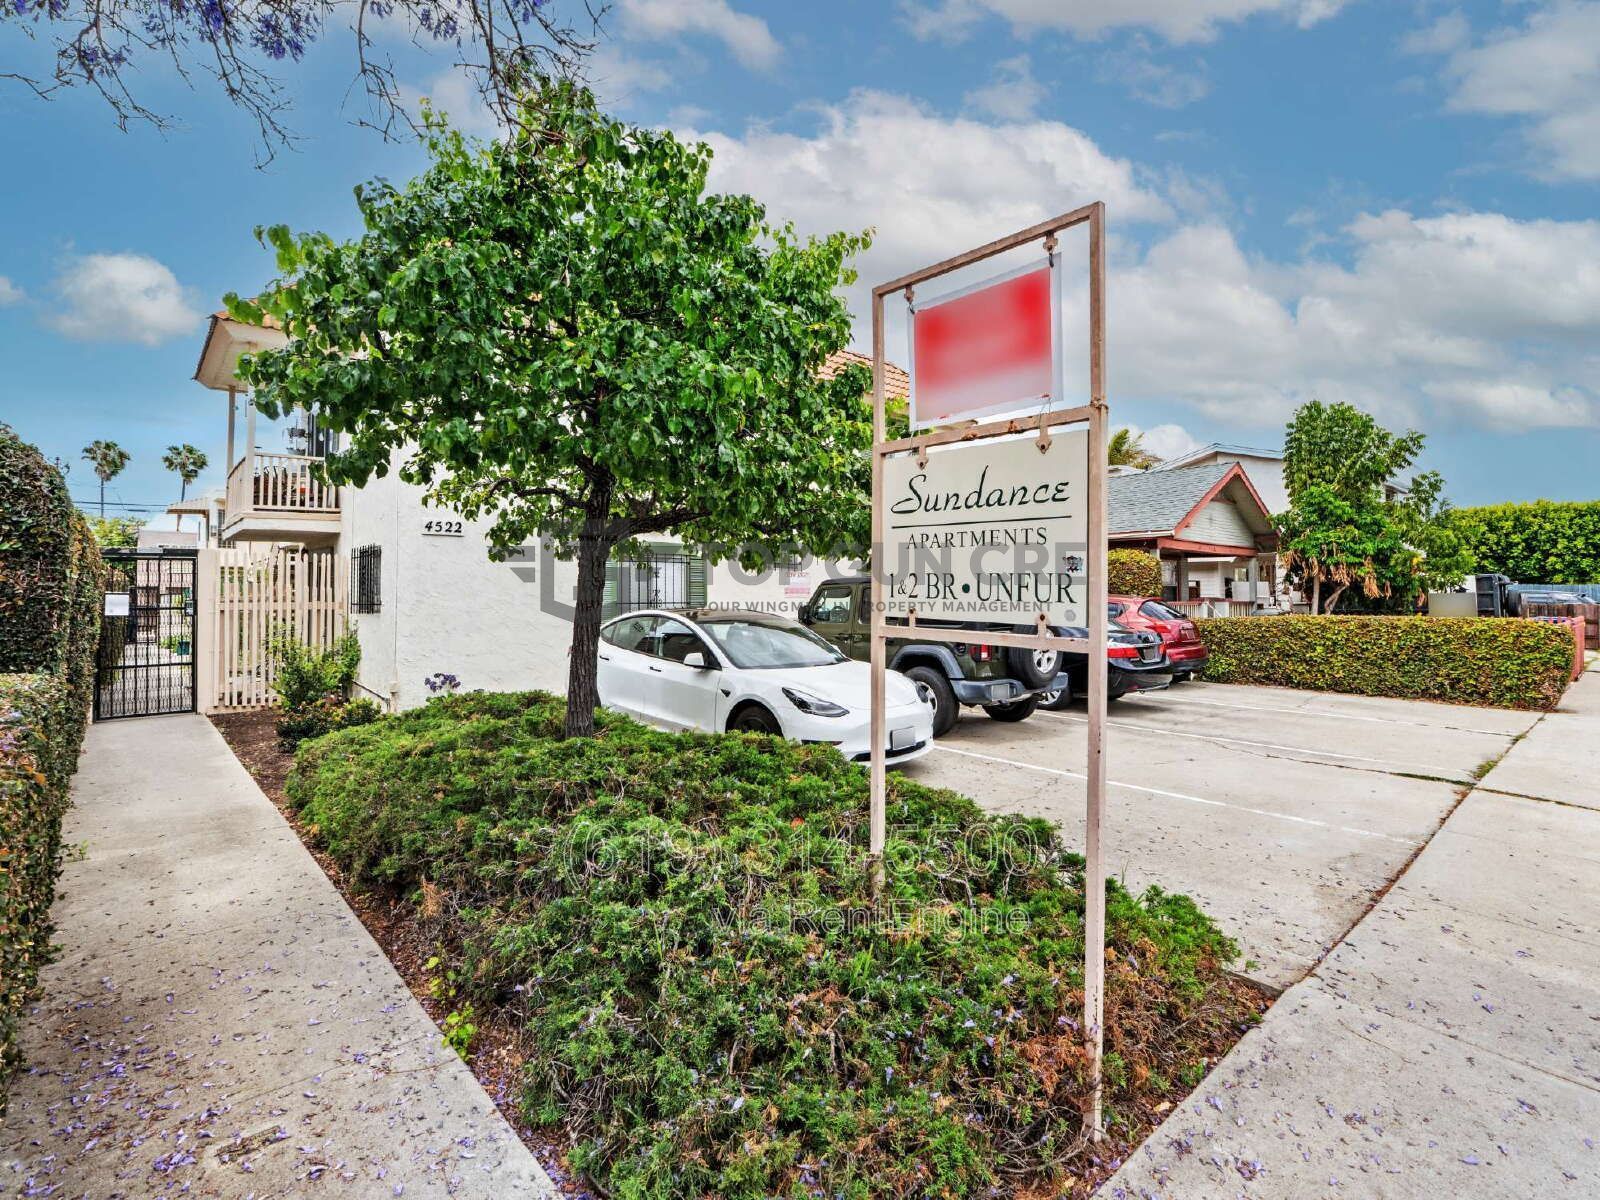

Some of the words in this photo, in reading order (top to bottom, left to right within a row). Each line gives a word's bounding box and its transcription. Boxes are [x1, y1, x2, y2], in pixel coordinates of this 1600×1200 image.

[890, 465, 1070, 514] Sundance
[424, 521, 463, 533] 4522
[906, 527, 1047, 550] APARTMENTS
[889, 572, 918, 599] 1&2
[975, 572, 1077, 604] UNFUR
